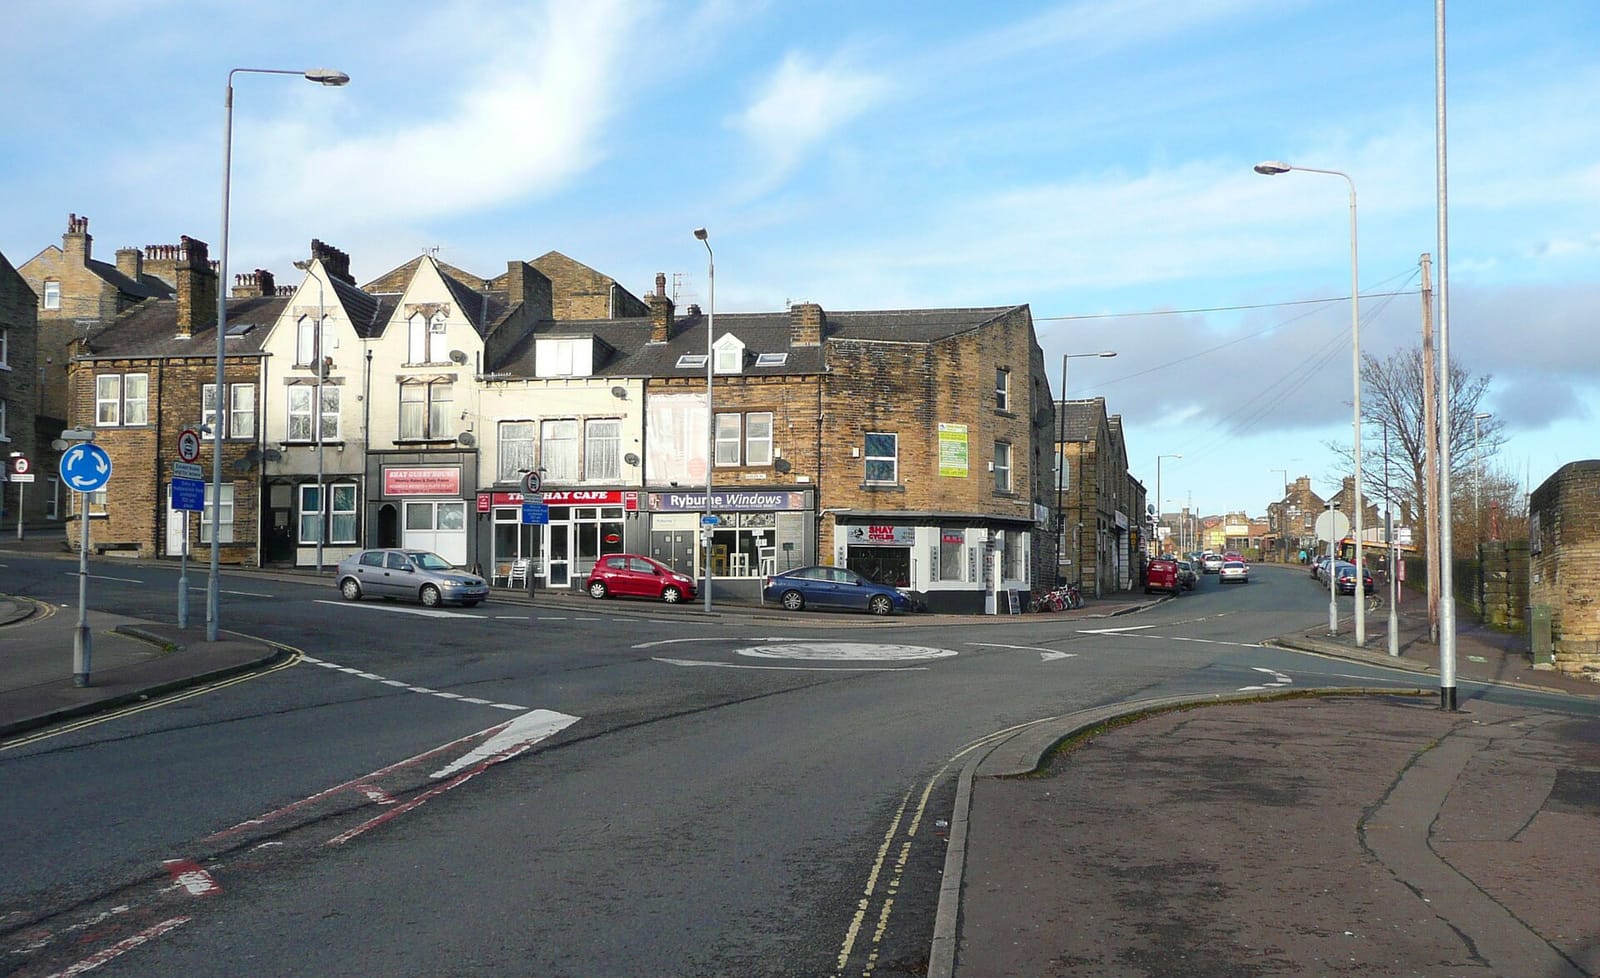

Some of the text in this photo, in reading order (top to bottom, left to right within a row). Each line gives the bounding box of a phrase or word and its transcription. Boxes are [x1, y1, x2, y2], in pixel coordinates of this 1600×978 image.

[543, 491, 570, 500] HAY
[573, 491, 608, 500] CAFE
[726, 493, 782, 504] Windows
[868, 525, 895, 533] SHAY
